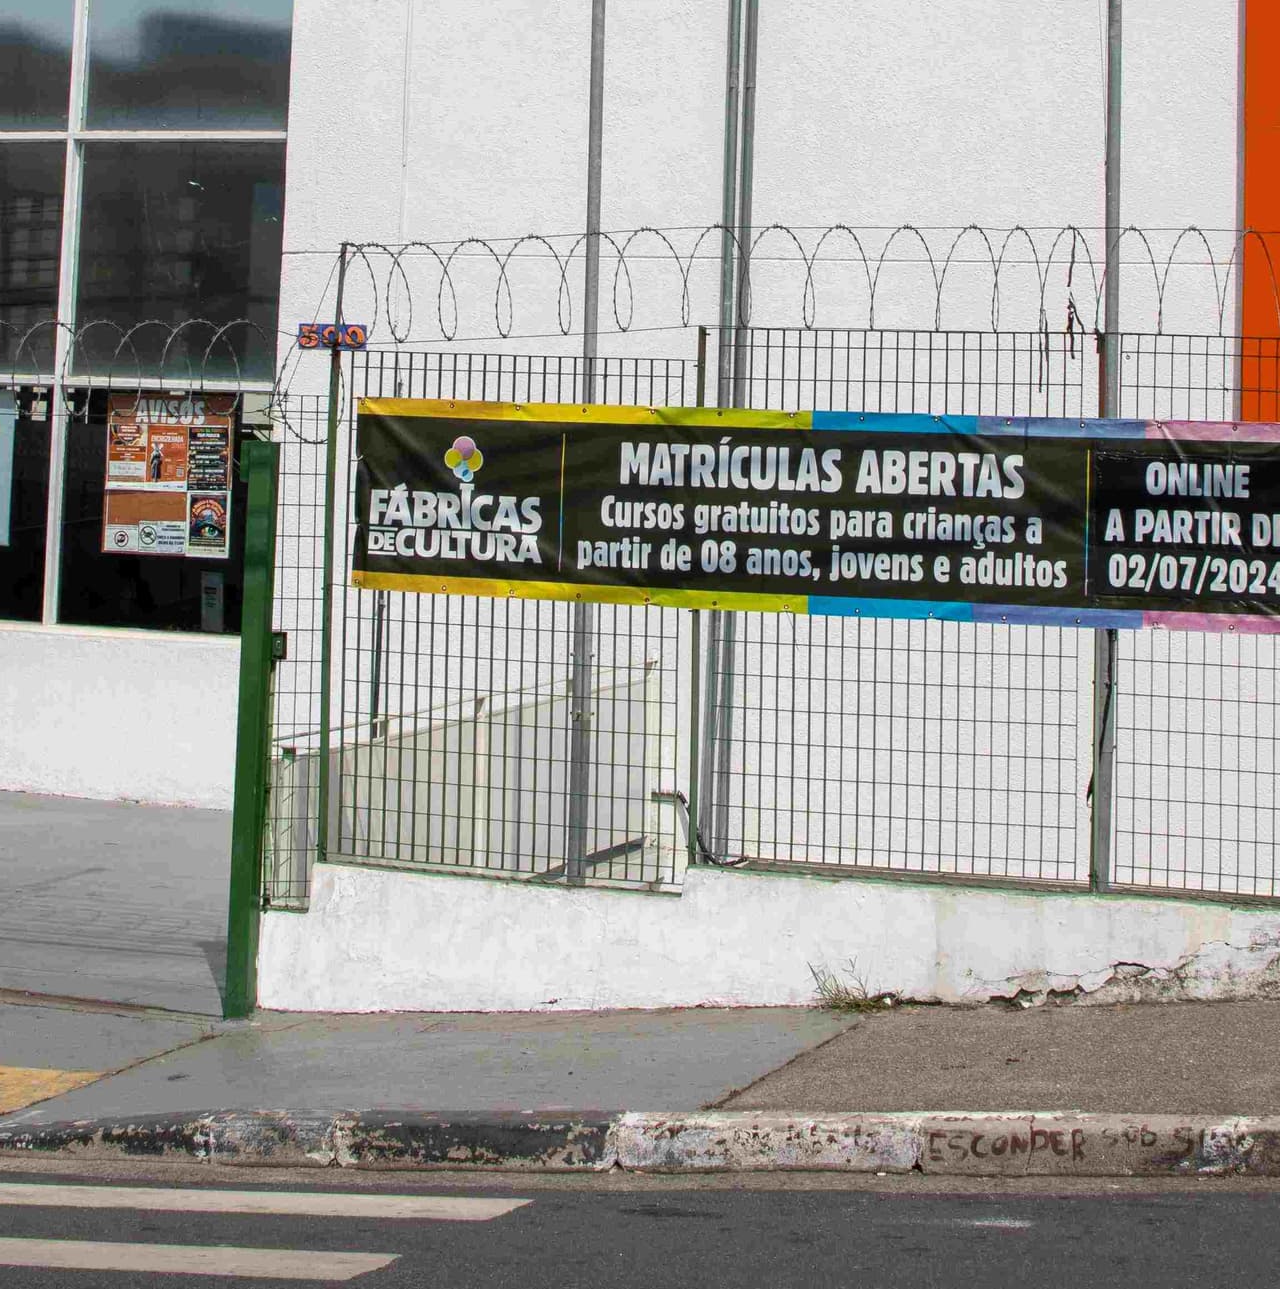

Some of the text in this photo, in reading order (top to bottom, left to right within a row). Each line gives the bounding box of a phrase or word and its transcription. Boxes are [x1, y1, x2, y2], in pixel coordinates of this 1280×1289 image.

[135, 399, 206, 425] AVISOS
[619, 436, 1025, 499] MATRÍCULAS ABERTAS
[1145, 461, 1251, 499] ONLINE
[369, 482, 543, 534] FÁBRICAS
[601, 495, 1043, 550] Cursos gratuitos para crianças a
[1104, 508, 1125, 542] A
[1134, 508, 1242, 546] PARTIR
[577, 536, 1068, 588] partir de 08 anos, jovens e adultos
